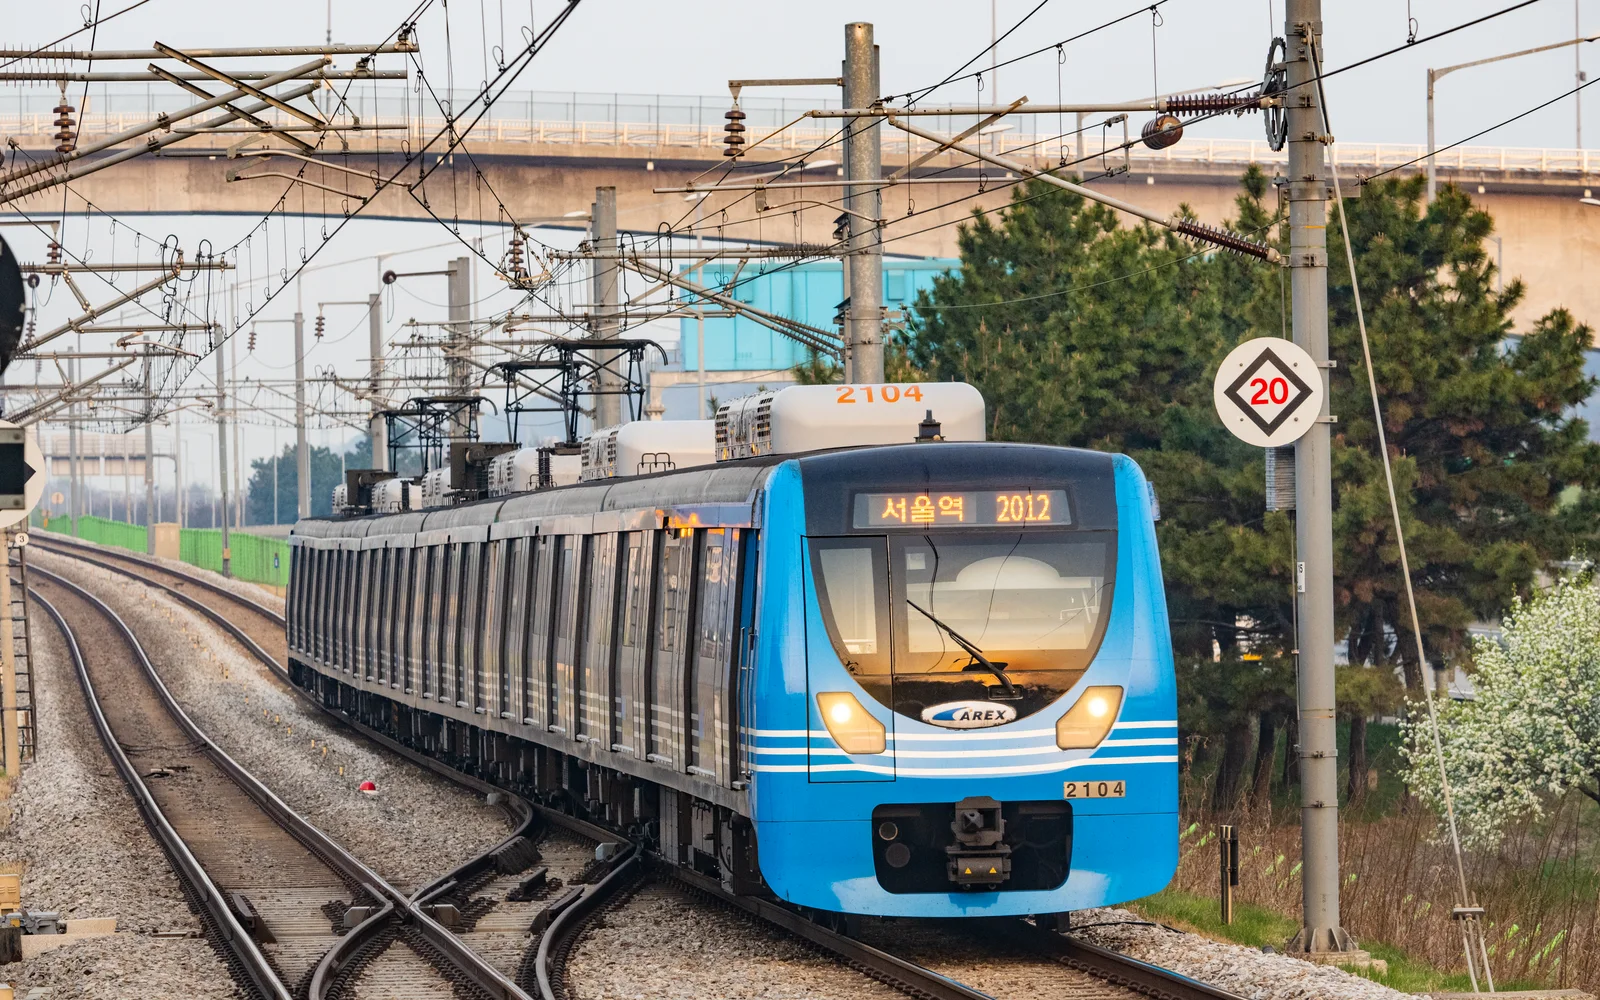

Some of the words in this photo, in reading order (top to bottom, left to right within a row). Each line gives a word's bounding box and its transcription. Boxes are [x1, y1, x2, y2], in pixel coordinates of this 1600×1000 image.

[836, 385, 923, 403] 2104
[1250, 377, 1289, 405] 20
[882, 495, 963, 523] 서울역
[997, 494, 1051, 522] 2012
[960, 709, 1007, 721] AREX
[1066, 781, 1124, 798] 2104
